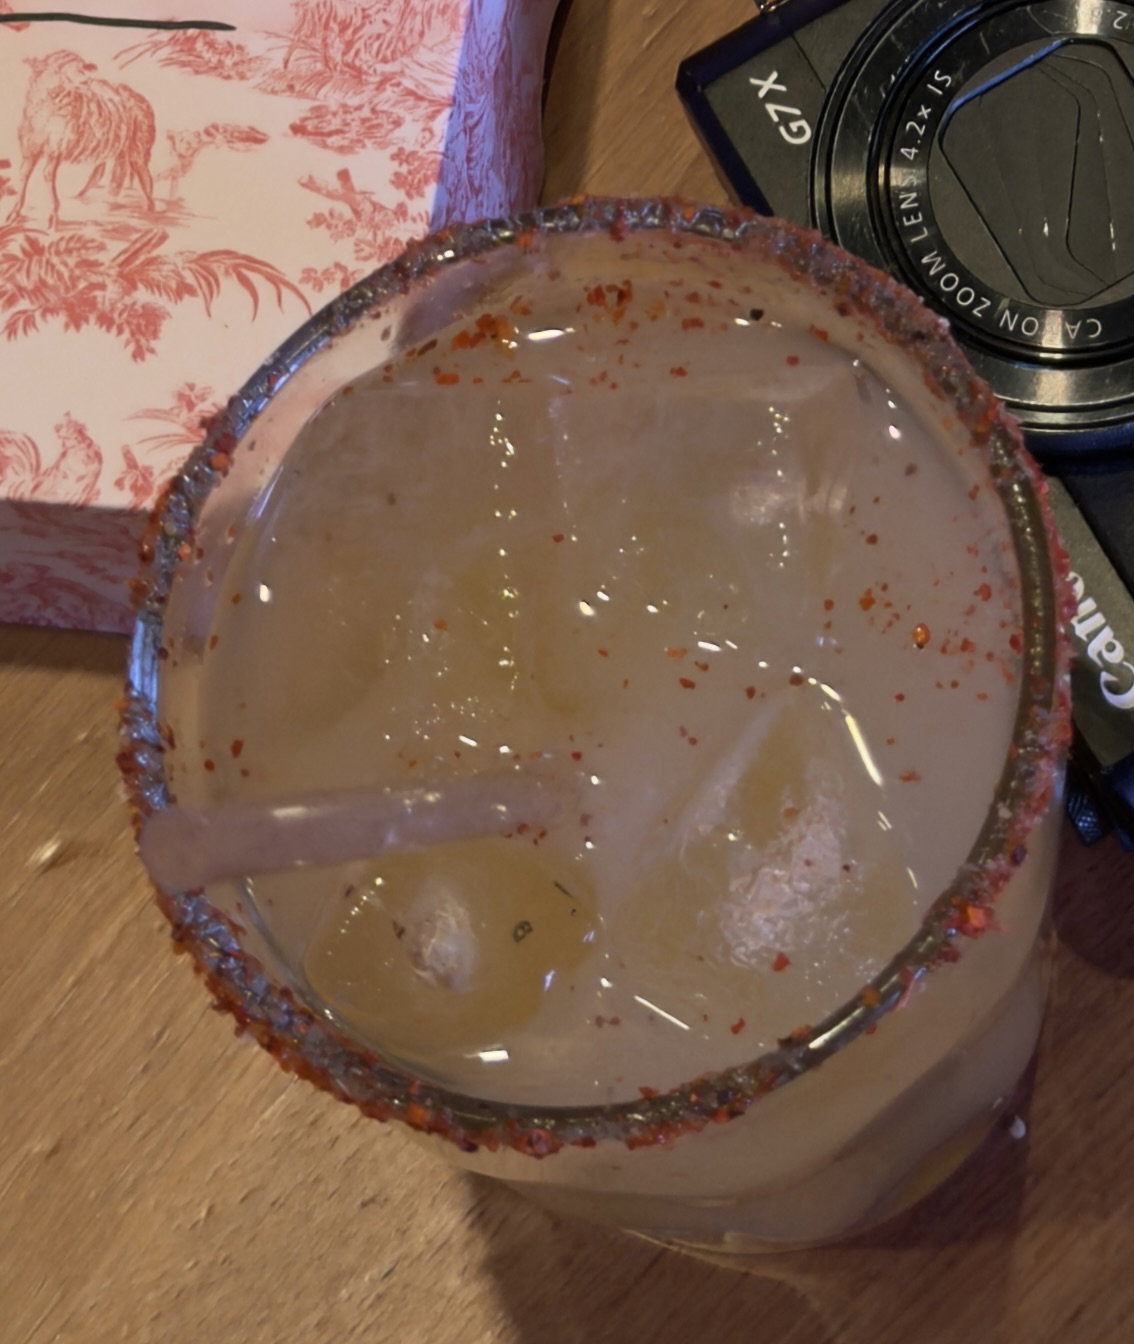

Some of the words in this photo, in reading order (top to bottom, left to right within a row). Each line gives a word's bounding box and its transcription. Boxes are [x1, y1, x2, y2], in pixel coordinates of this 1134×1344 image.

[927, 70, 952, 95] IS
[899, 104, 932, 160] 4.2x
[921, 251, 991, 318] ZOOM
